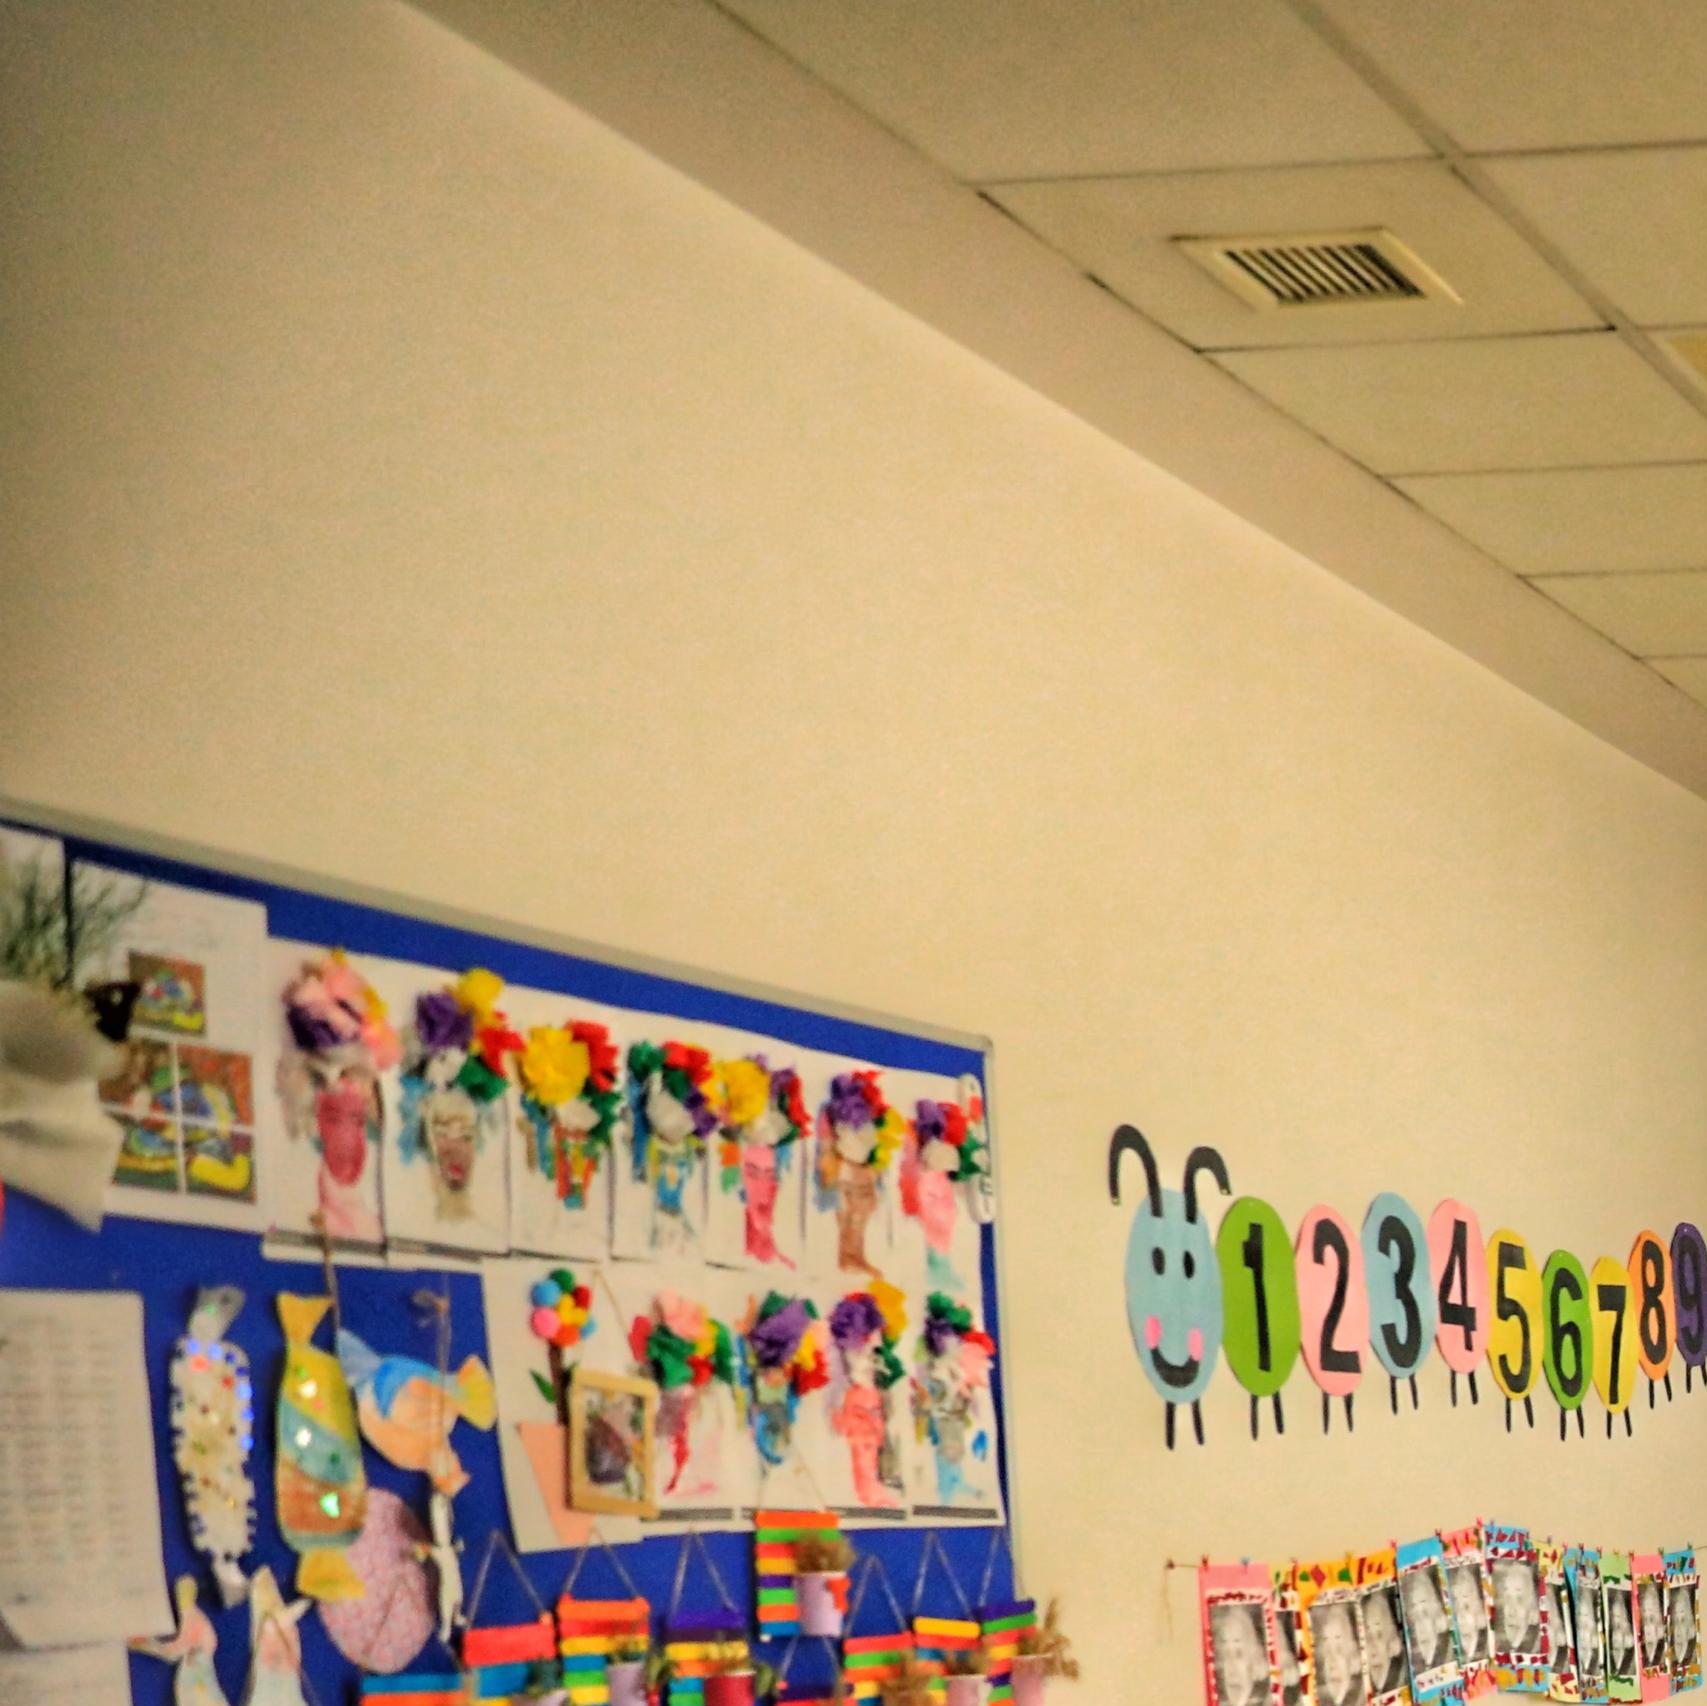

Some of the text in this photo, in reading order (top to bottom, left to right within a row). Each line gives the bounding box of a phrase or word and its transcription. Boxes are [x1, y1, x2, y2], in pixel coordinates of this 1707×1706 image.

[1243, 1215, 1705, 1405] 1 2 3 4 5 6 7 8 9
